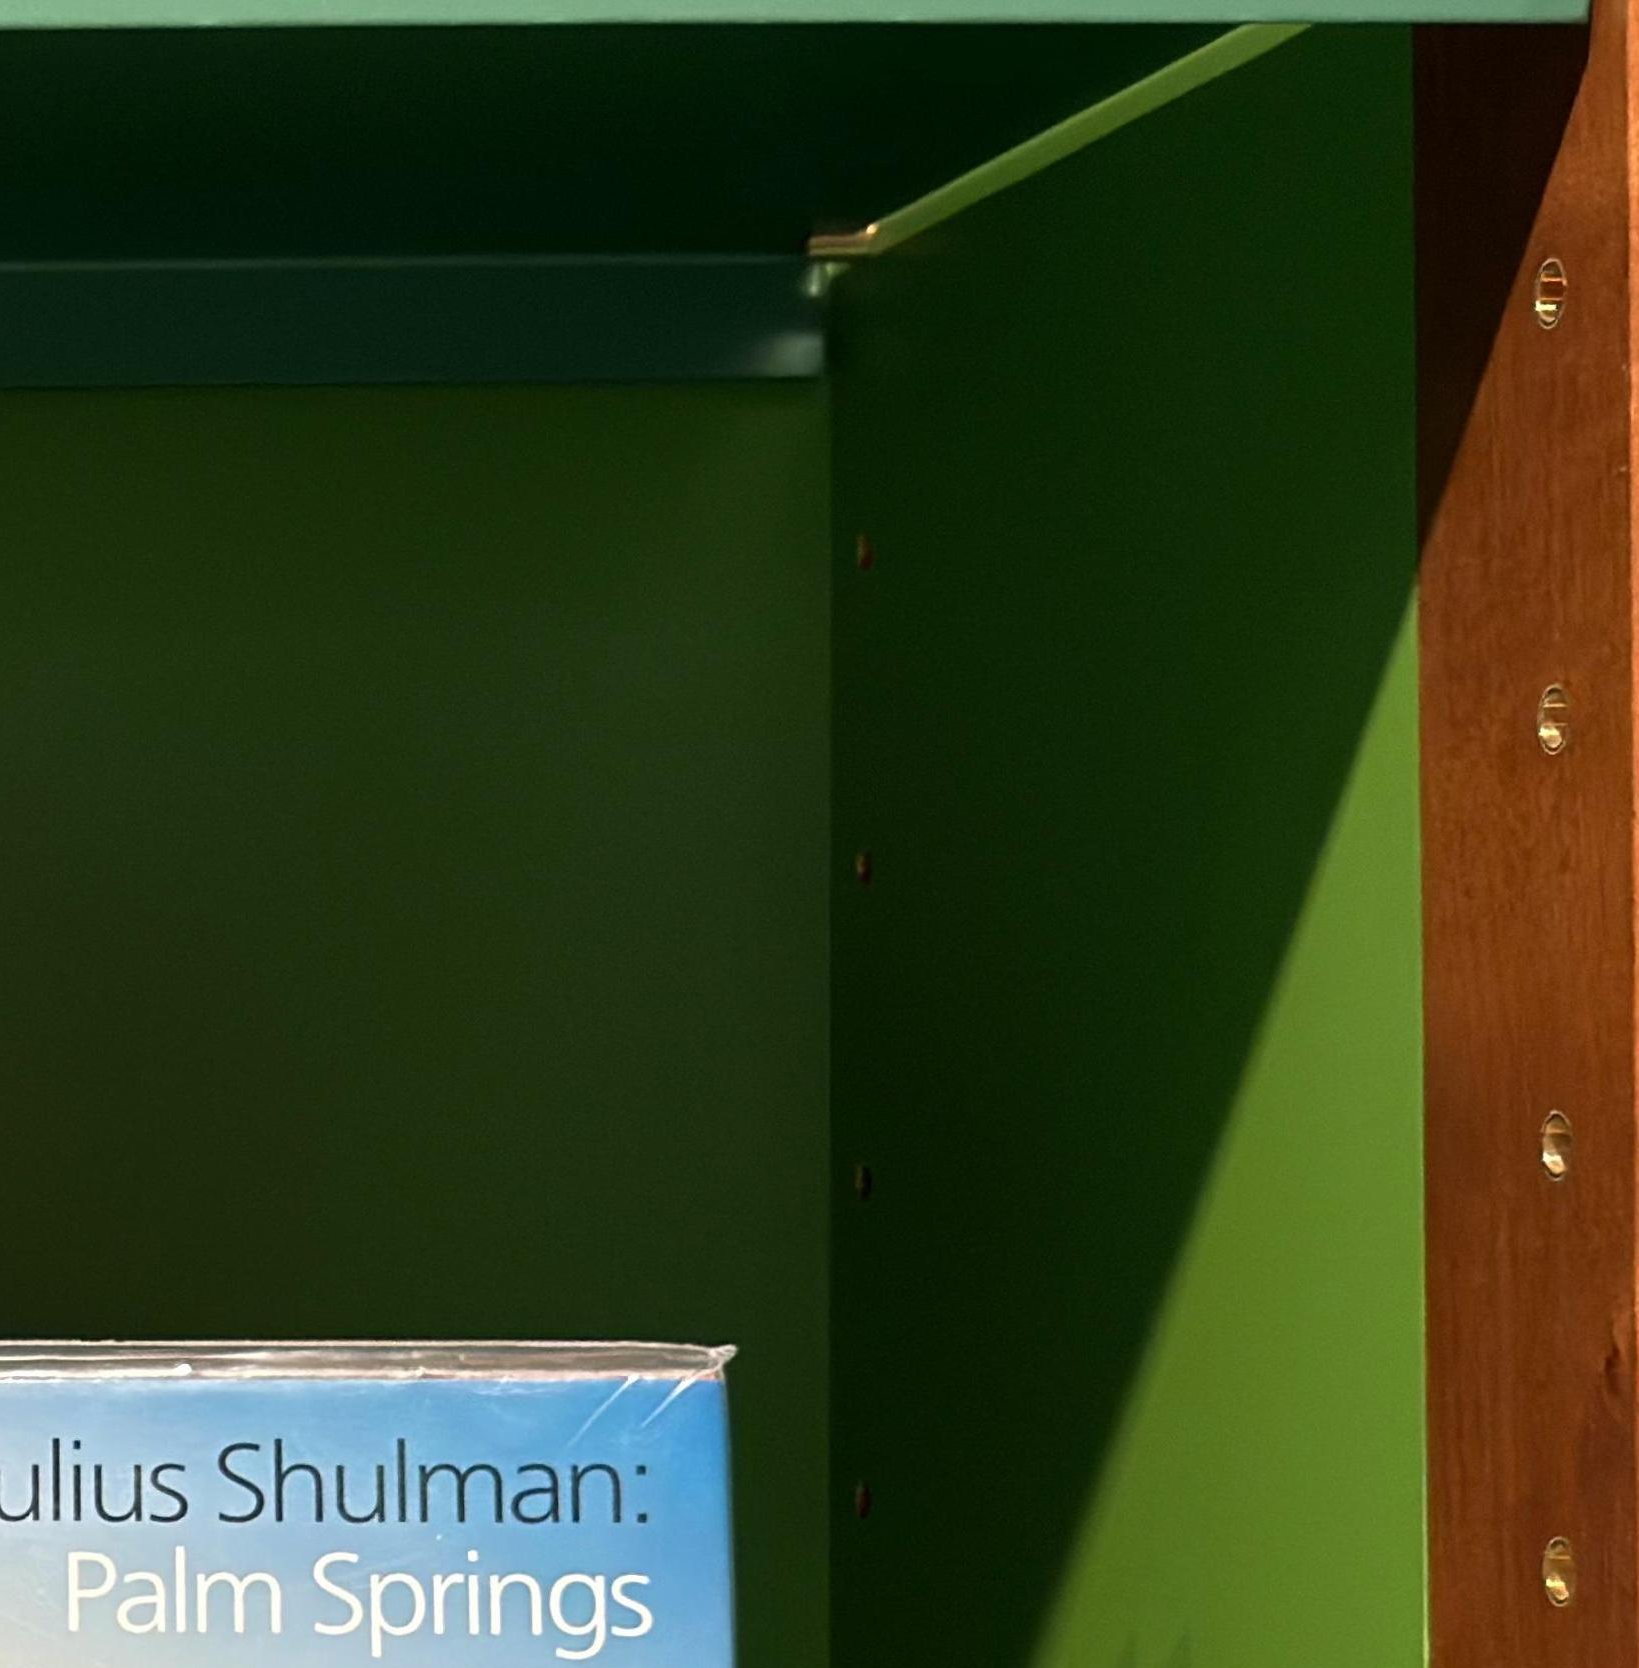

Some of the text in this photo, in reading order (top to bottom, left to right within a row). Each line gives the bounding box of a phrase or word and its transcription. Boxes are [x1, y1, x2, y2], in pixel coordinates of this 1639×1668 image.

[217, 1437, 648, 1525] Shulman:
[68, 1546, 654, 1661] Palm Springs
